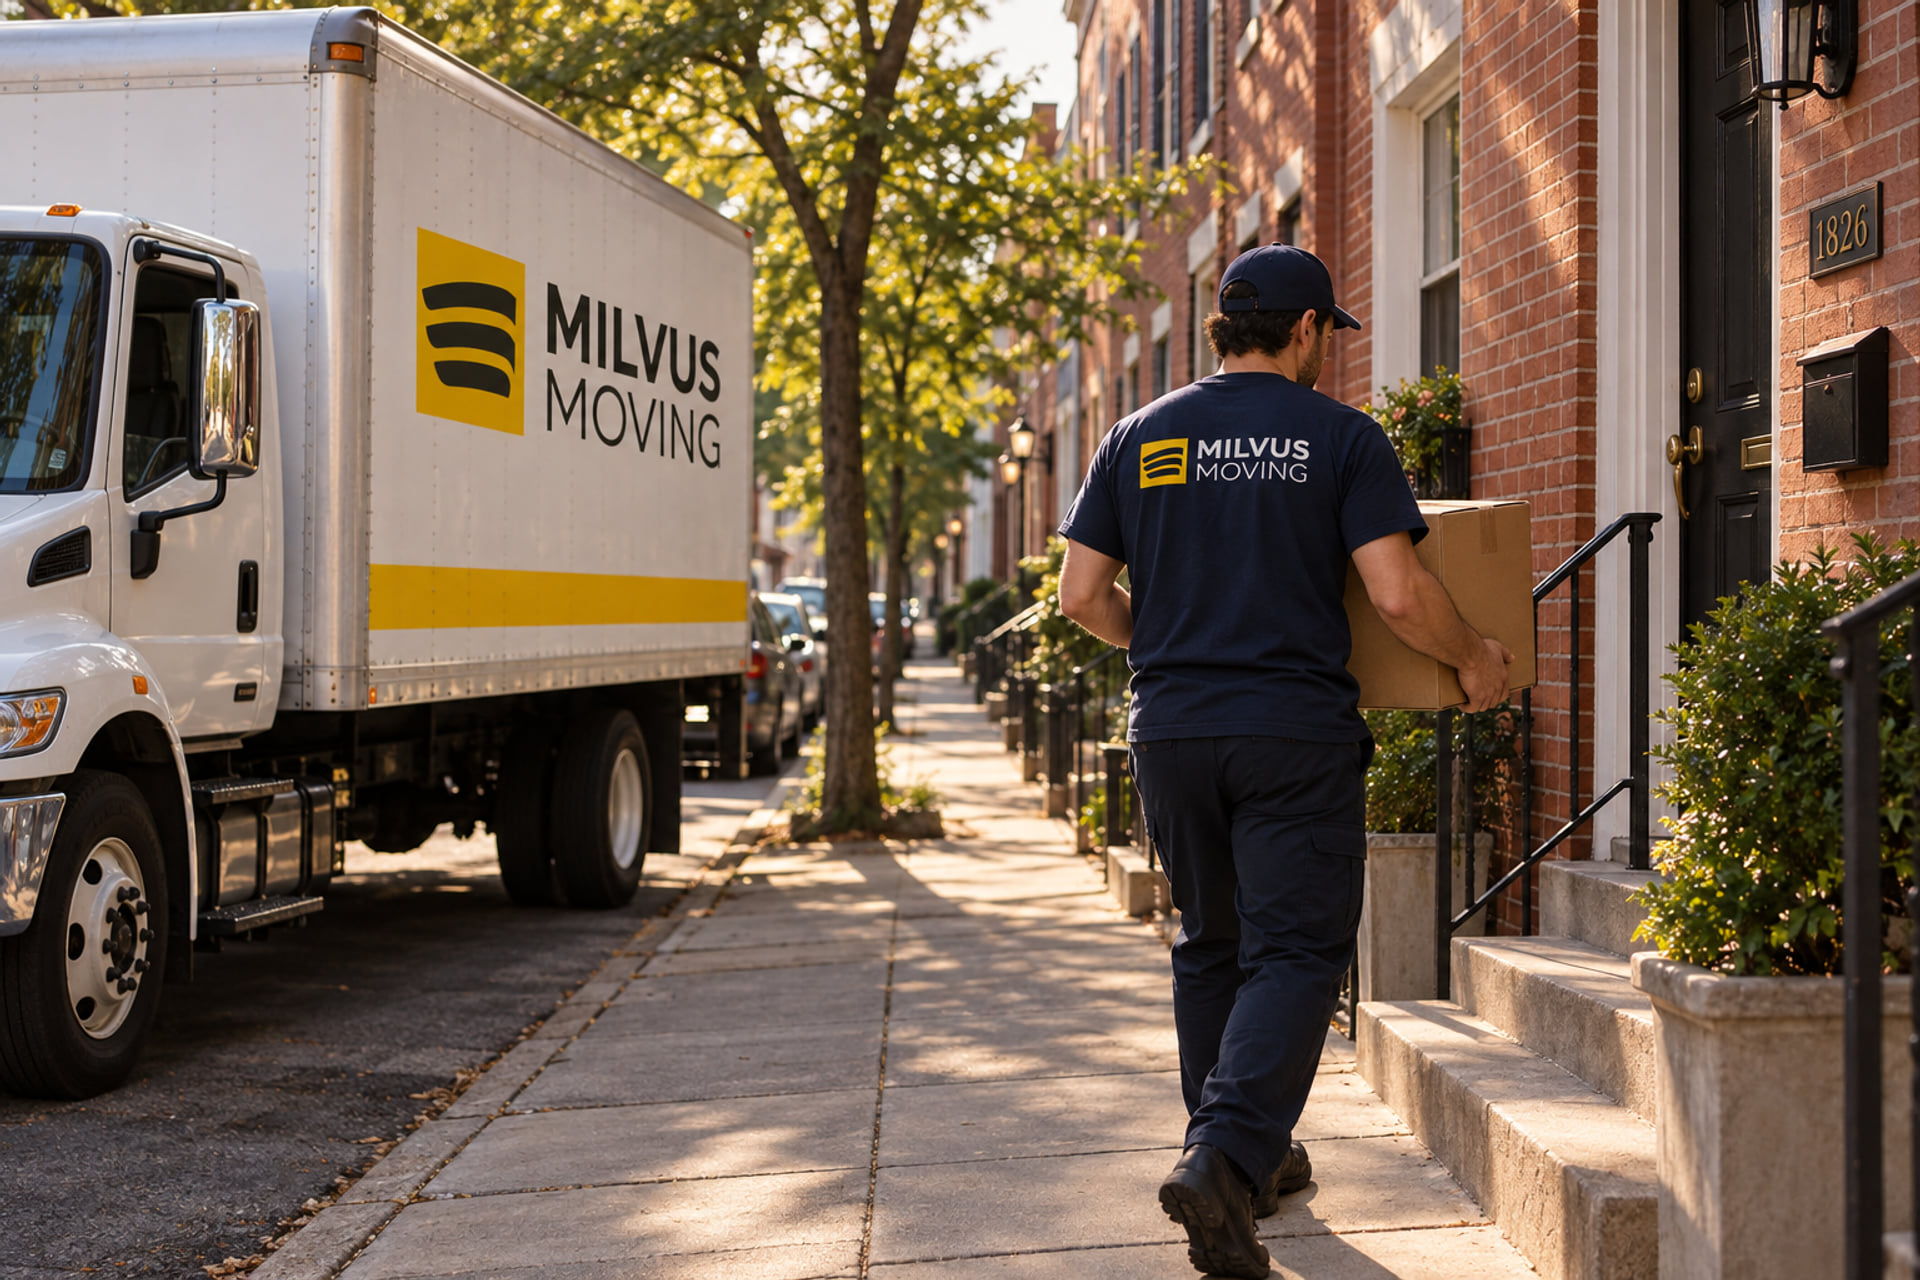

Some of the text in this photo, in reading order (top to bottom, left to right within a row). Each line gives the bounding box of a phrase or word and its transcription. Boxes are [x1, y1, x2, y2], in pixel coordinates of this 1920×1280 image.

[1816, 203, 1867, 260] 1826
[547, 282, 720, 402] MILVUS
[547, 368, 720, 468] MOVING
[1196, 461, 1307, 483] MOVING
[1197, 437, 1310, 460] MILVUS
